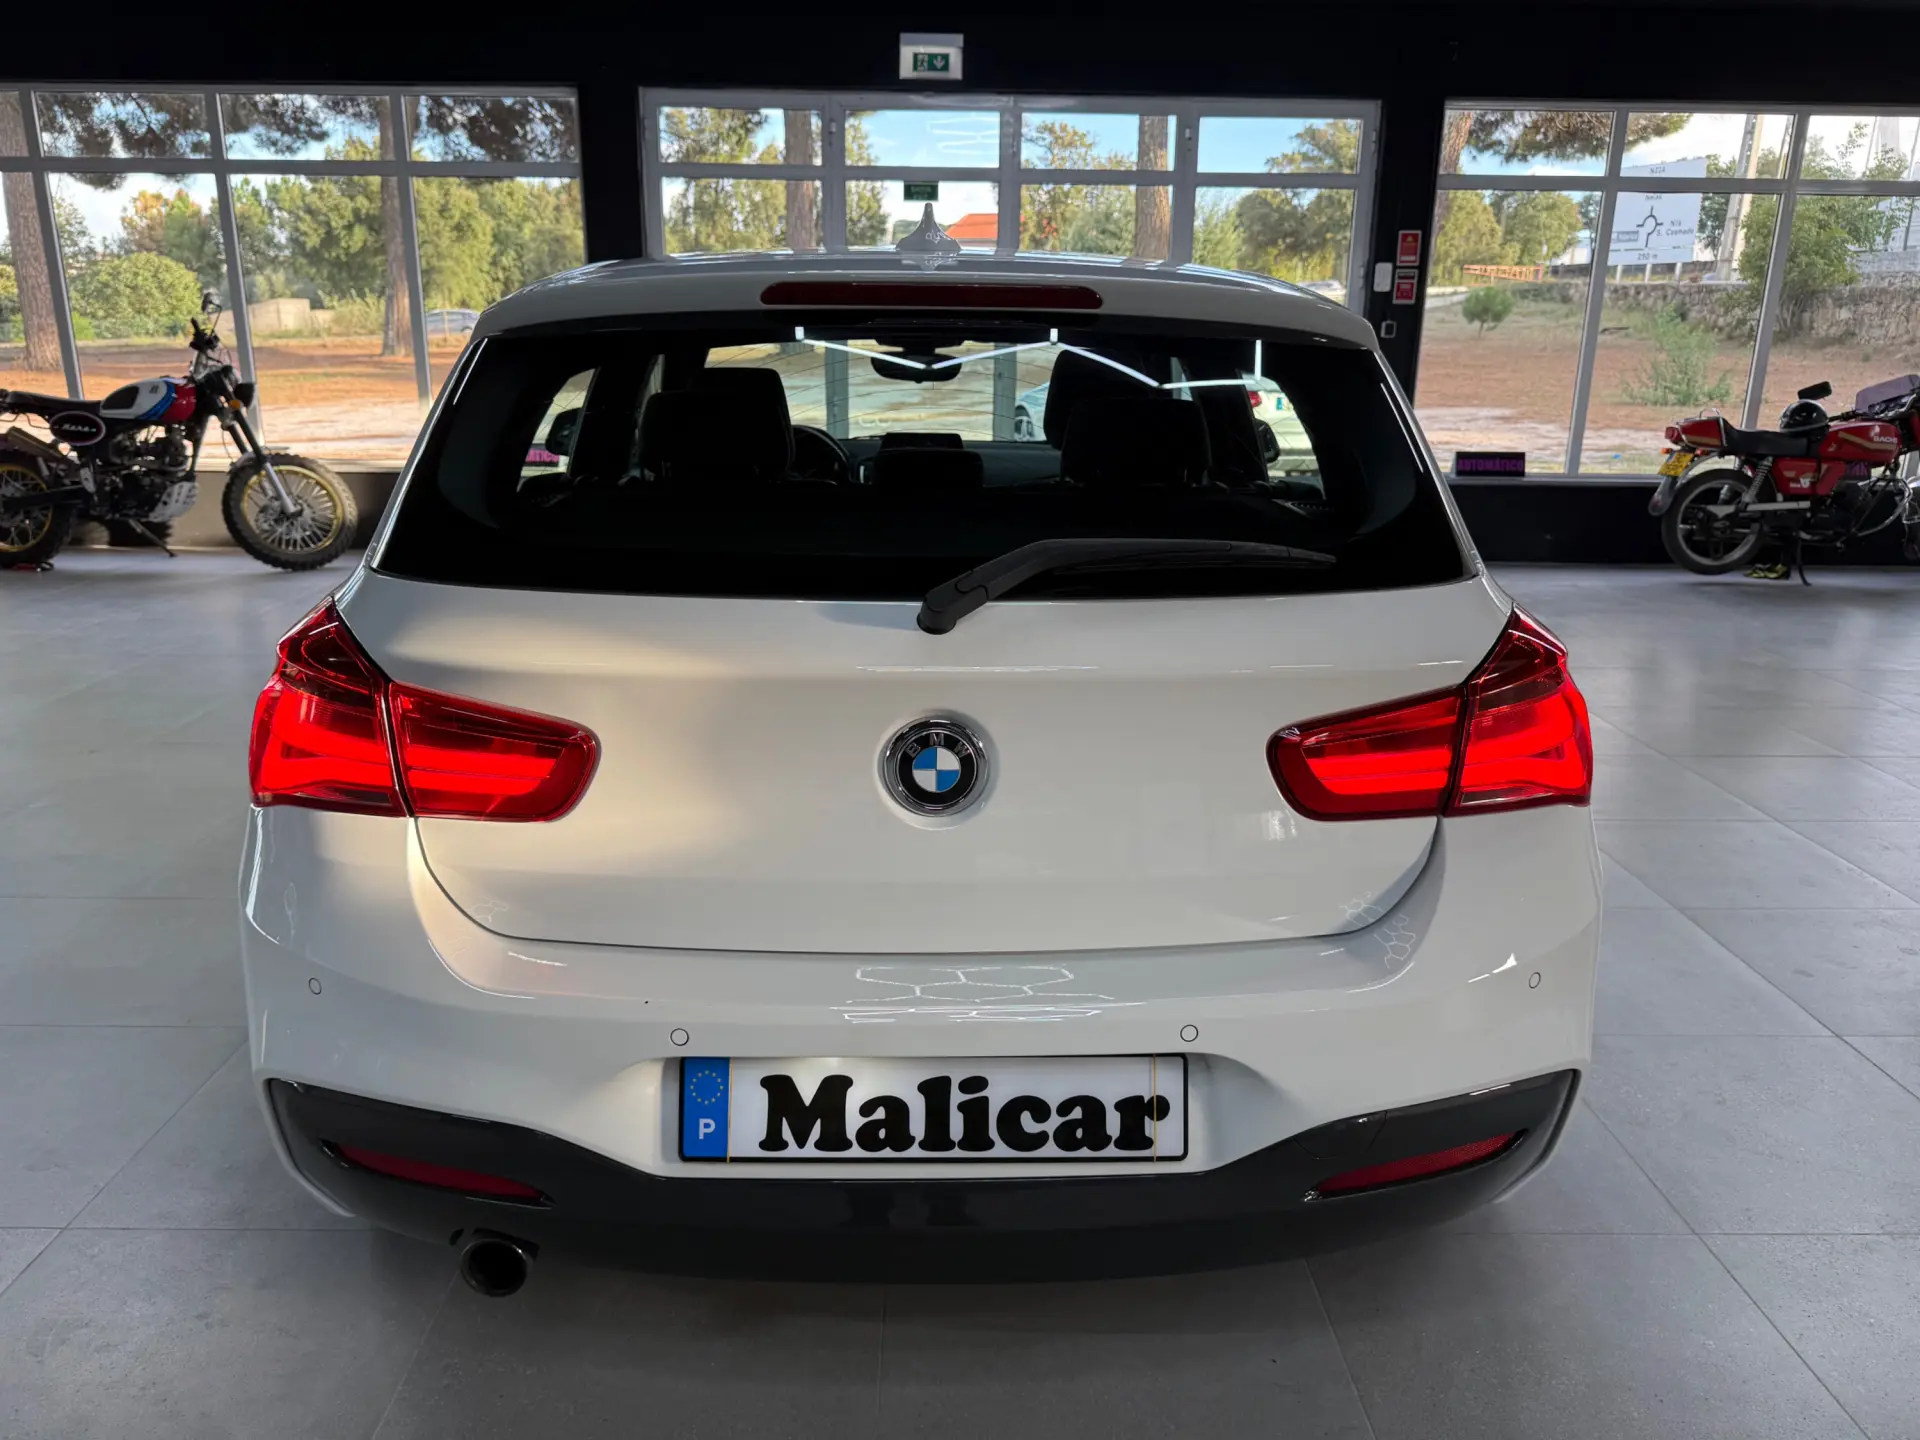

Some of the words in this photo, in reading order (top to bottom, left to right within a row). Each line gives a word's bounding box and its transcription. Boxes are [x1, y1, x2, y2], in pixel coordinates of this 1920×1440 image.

[905, 732, 970, 758] BMW
[759, 1074, 1170, 1153] Malicar
[699, 1119, 715, 1139] P
